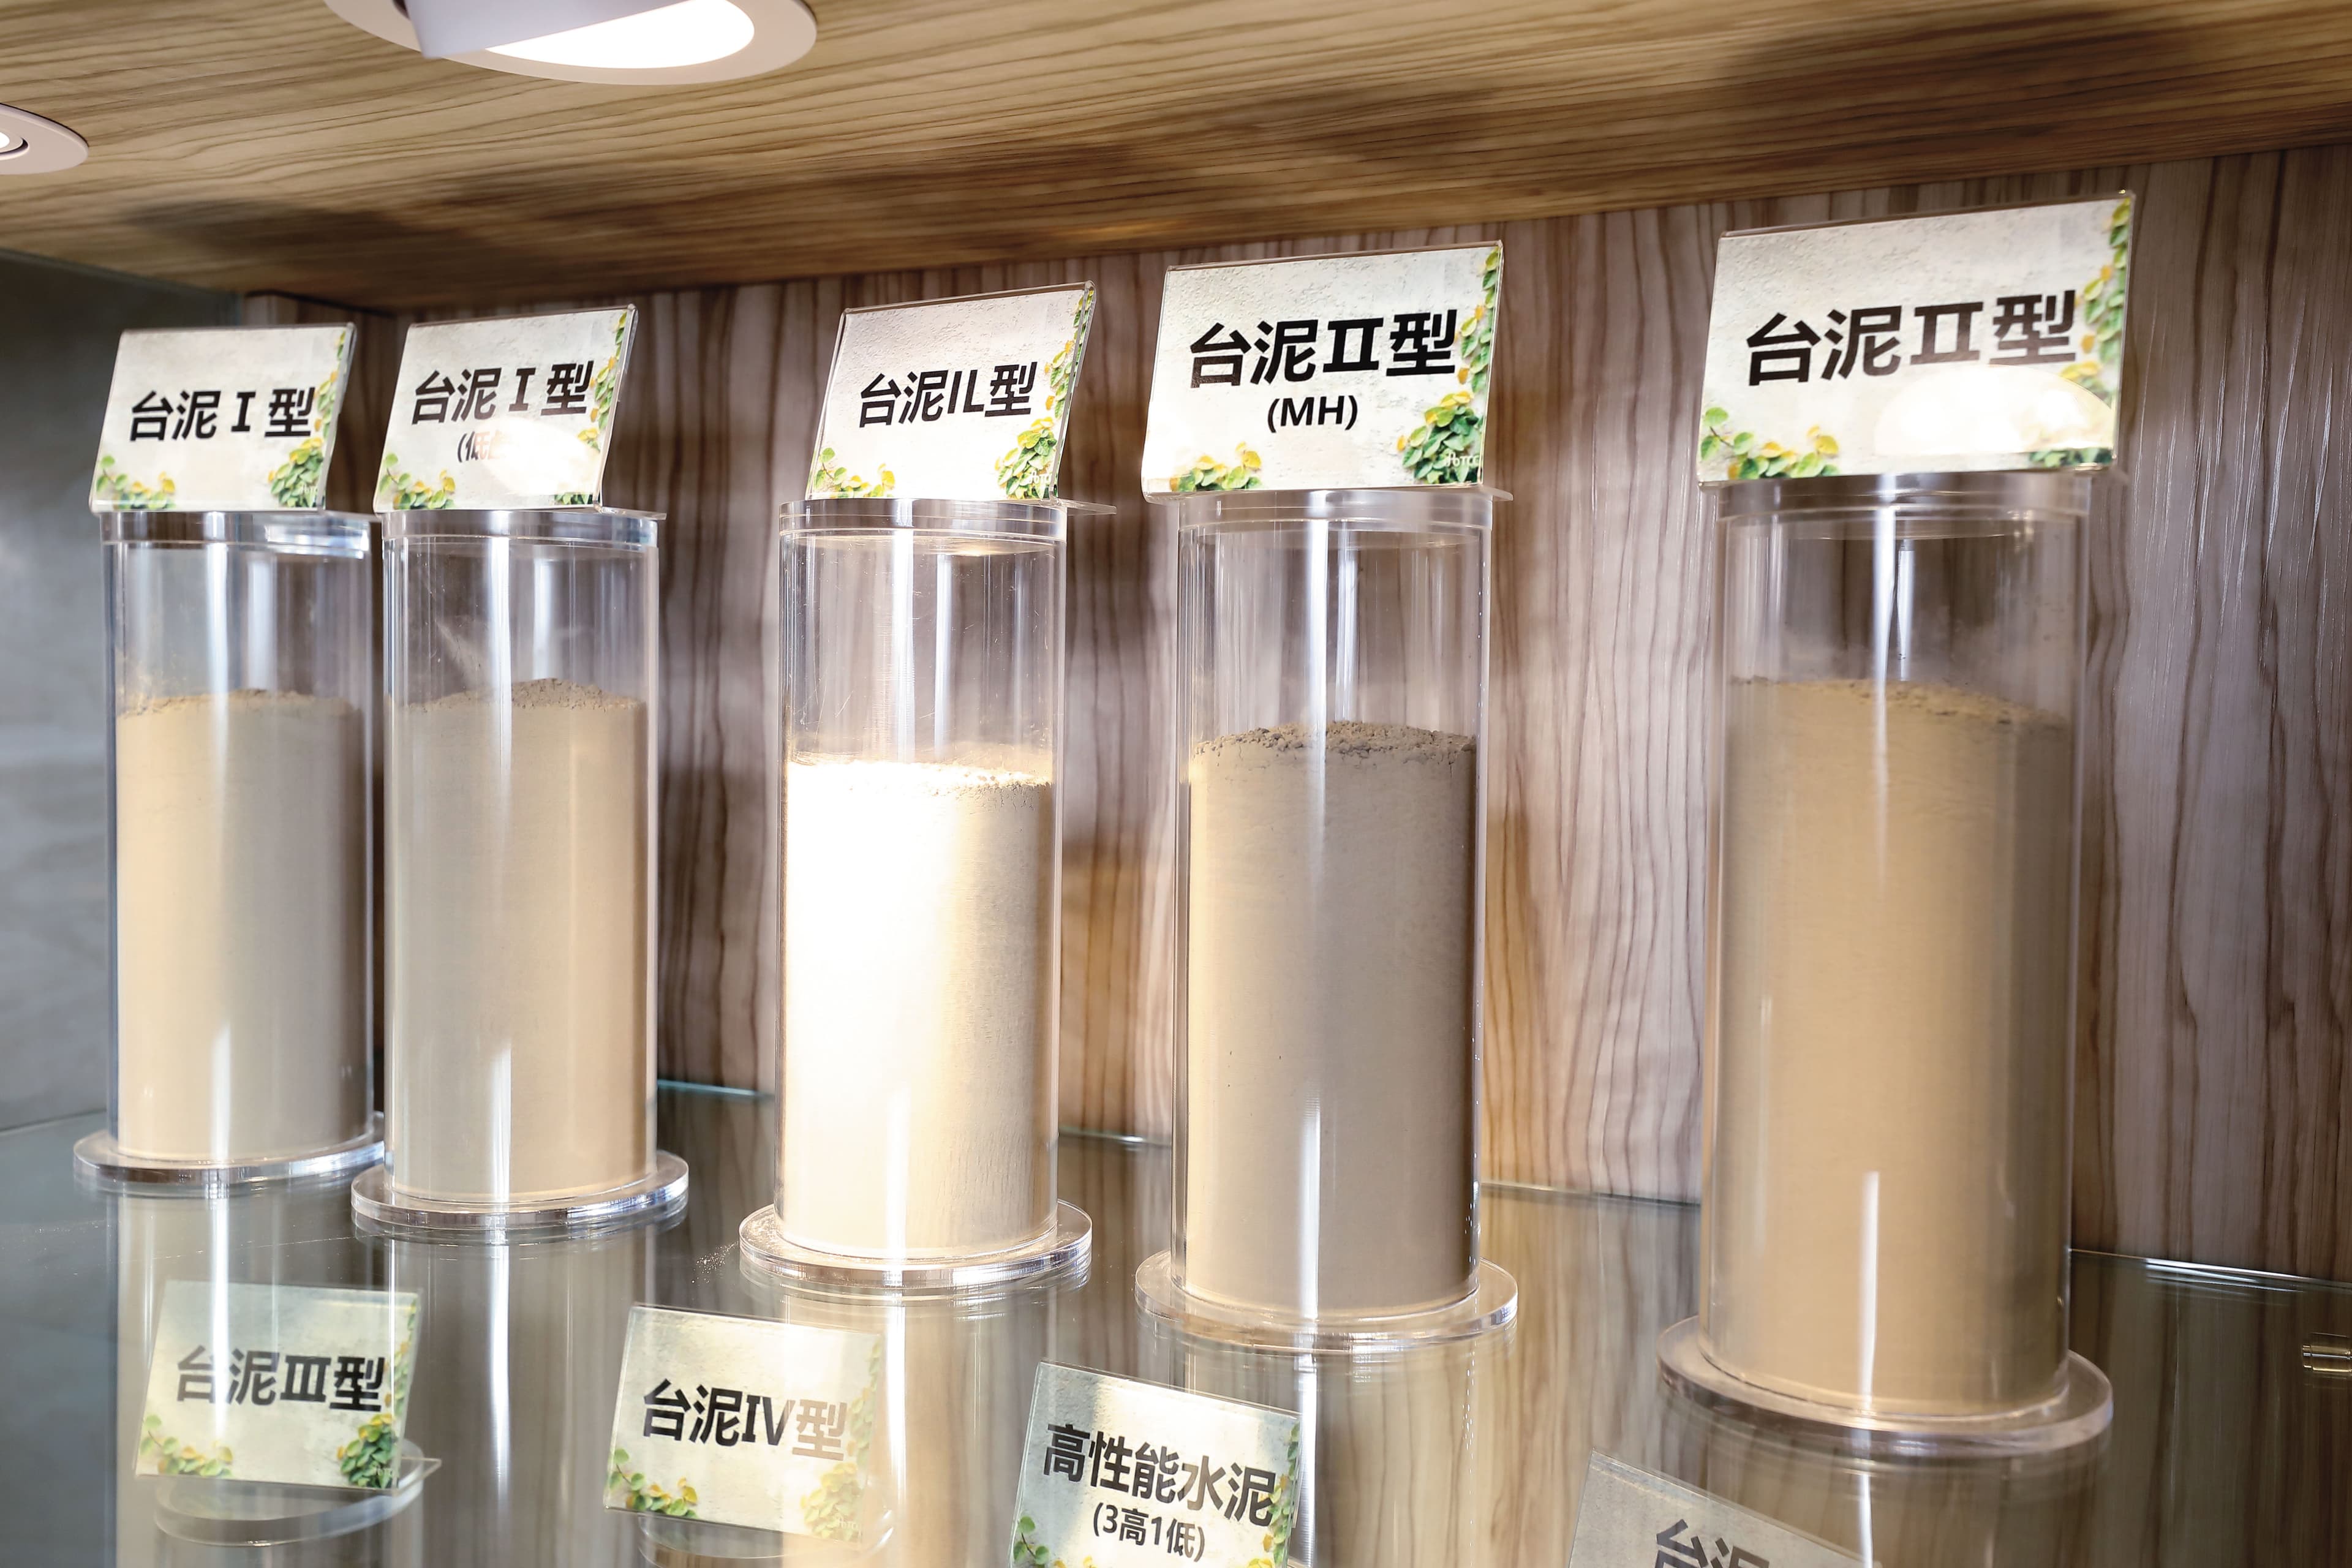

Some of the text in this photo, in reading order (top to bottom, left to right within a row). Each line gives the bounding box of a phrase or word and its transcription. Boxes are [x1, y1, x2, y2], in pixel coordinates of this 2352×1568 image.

[859, 361, 1038, 428] 台泥IL型
[1267, 395, 1358, 433] (MH)
[1043, 1423, 1276, 1527] 高性能水泥
[1093, 1502, 1205, 1562] (3高1低)
